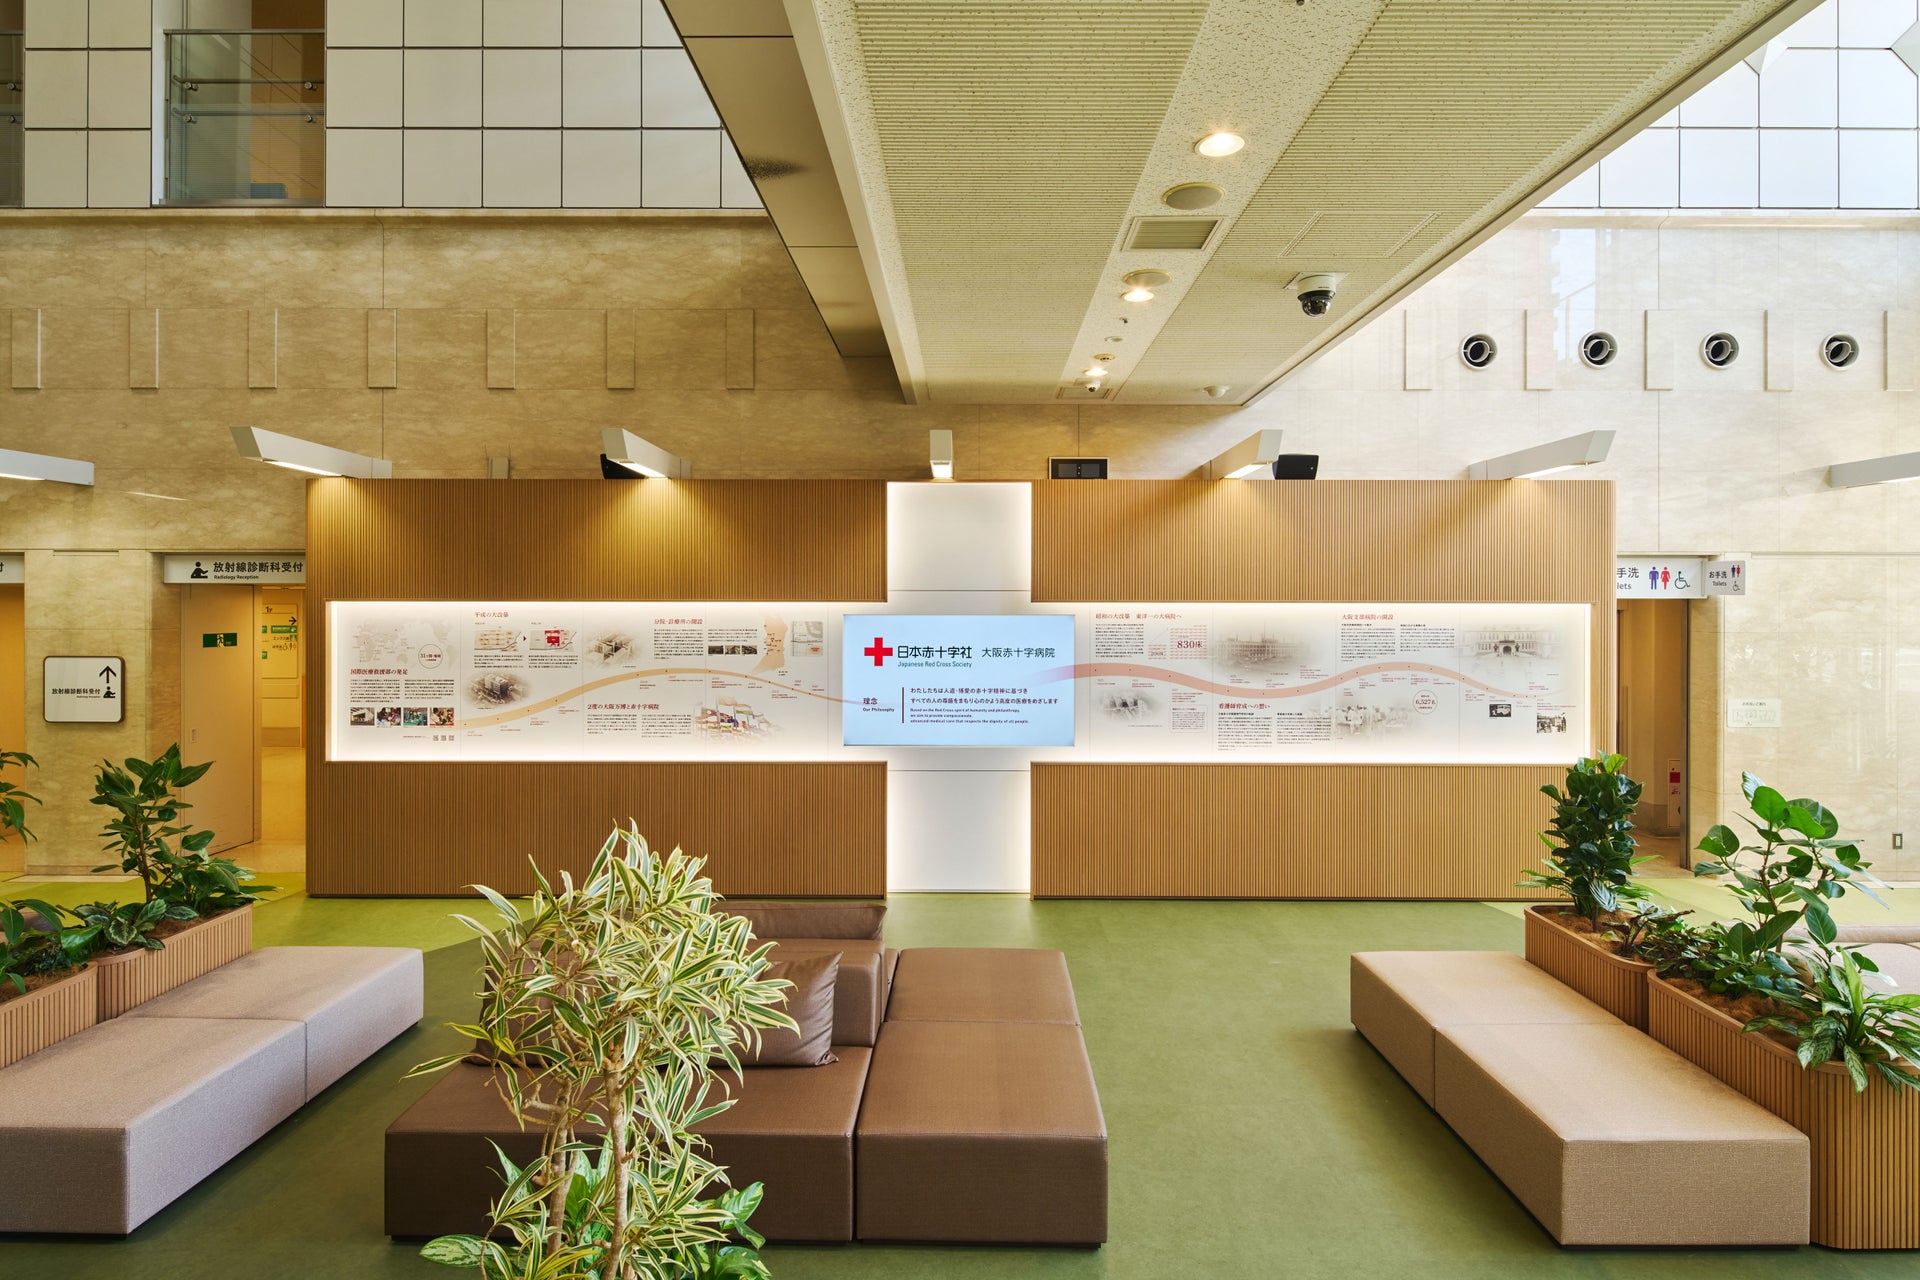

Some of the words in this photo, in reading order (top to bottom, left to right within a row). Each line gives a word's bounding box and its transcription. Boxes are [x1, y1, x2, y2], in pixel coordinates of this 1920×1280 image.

[213, 562, 304, 573] 放射線診断科受付
[1709, 570, 1727, 578] お手洗
[898, 646, 972, 658] 日本赤十字社
[982, 647, 1055, 658] 大阪赤十字病院
